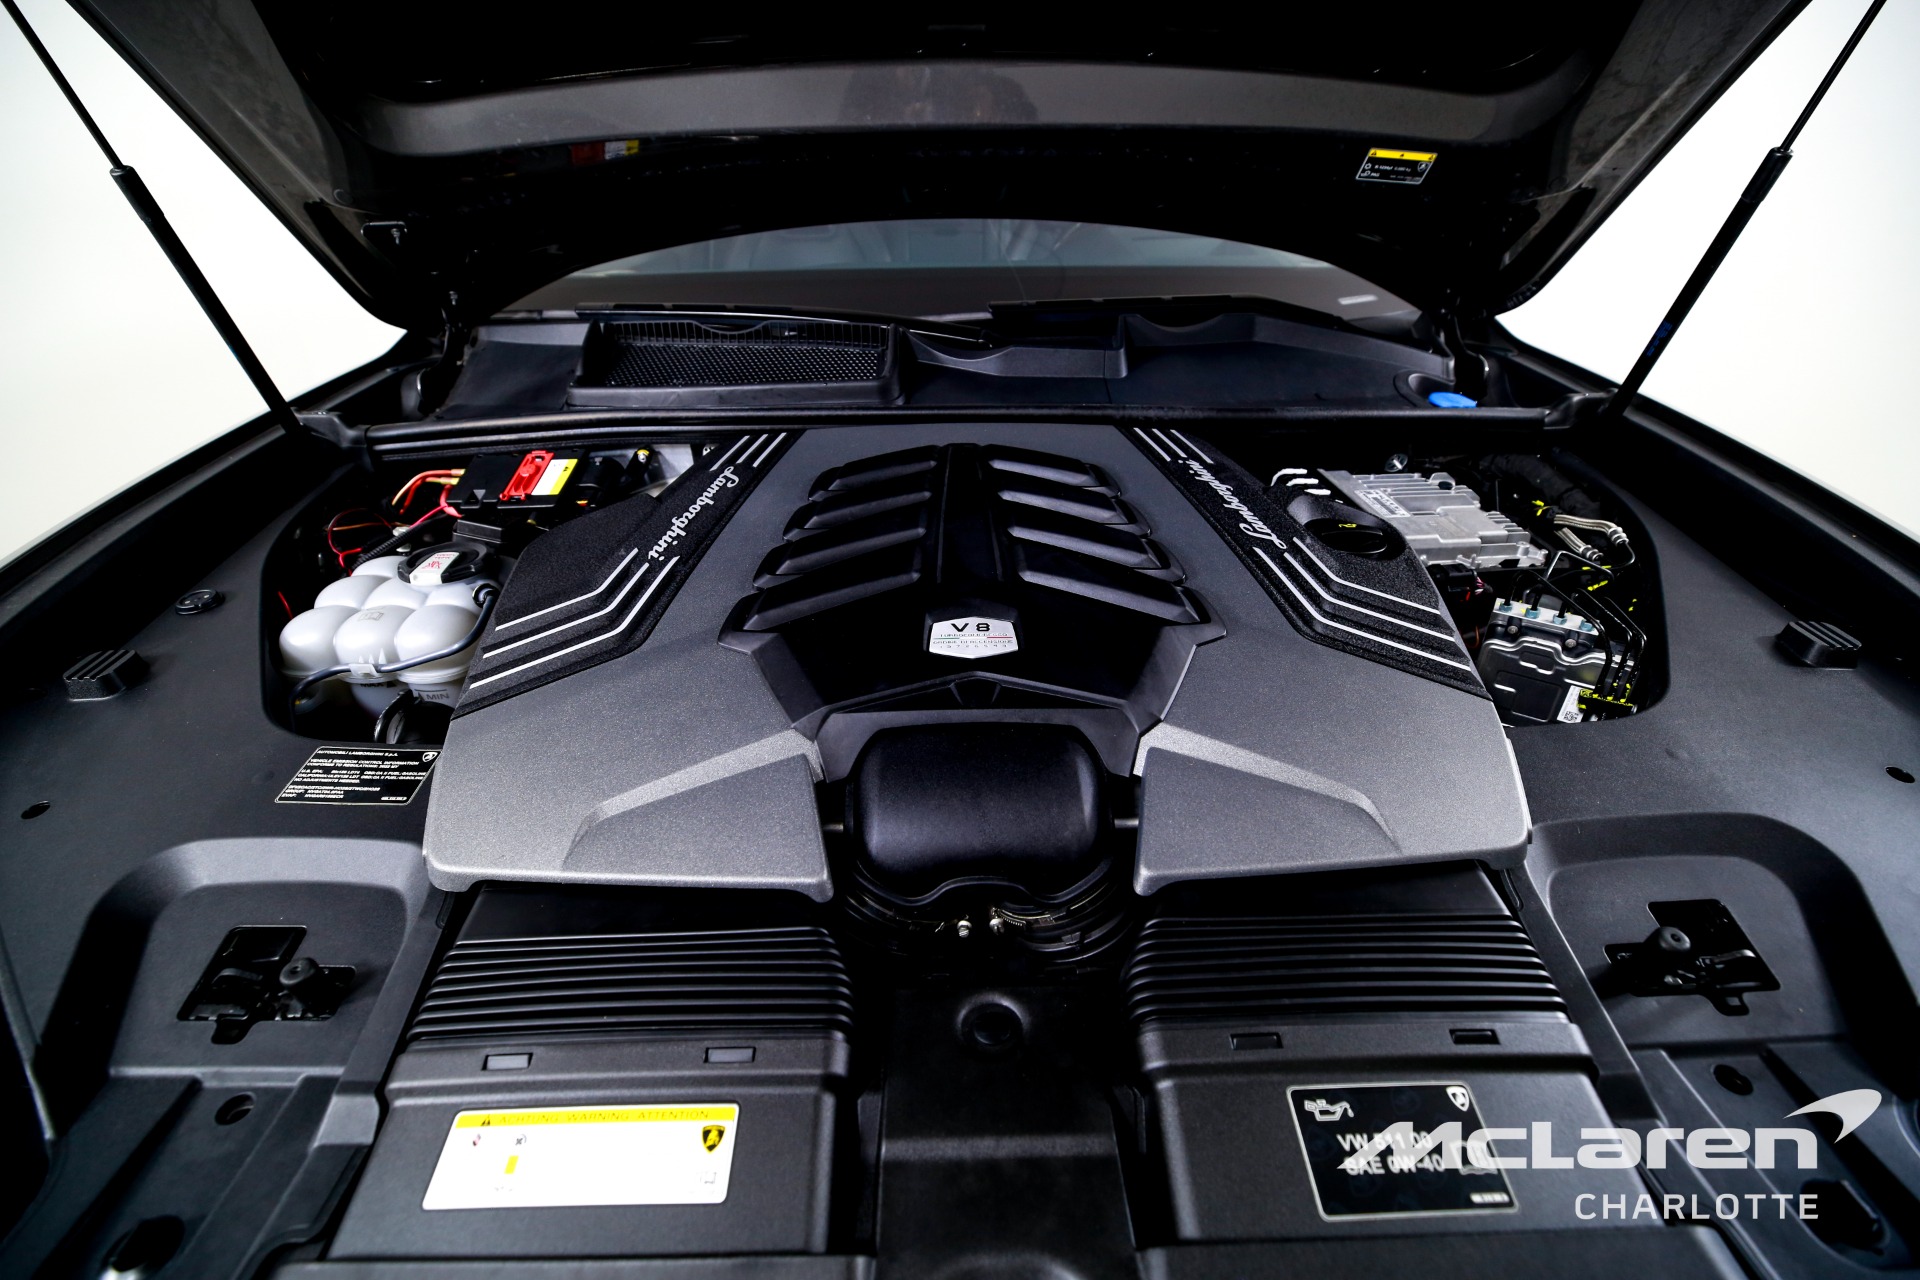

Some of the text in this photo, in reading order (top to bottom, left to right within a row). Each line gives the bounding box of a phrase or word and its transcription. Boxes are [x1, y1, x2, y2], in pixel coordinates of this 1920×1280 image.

[648, 465, 740, 561] Lamborghini
[1177, 459, 1287, 550] Lamborghini
[425, 692, 450, 700] MIN
[500, 1110, 709, 1124] ACHTUNG WARNING ATTENTION
[1336, 1133, 1370, 1151] VW
[1343, 1156, 1385, 1176] SAE
